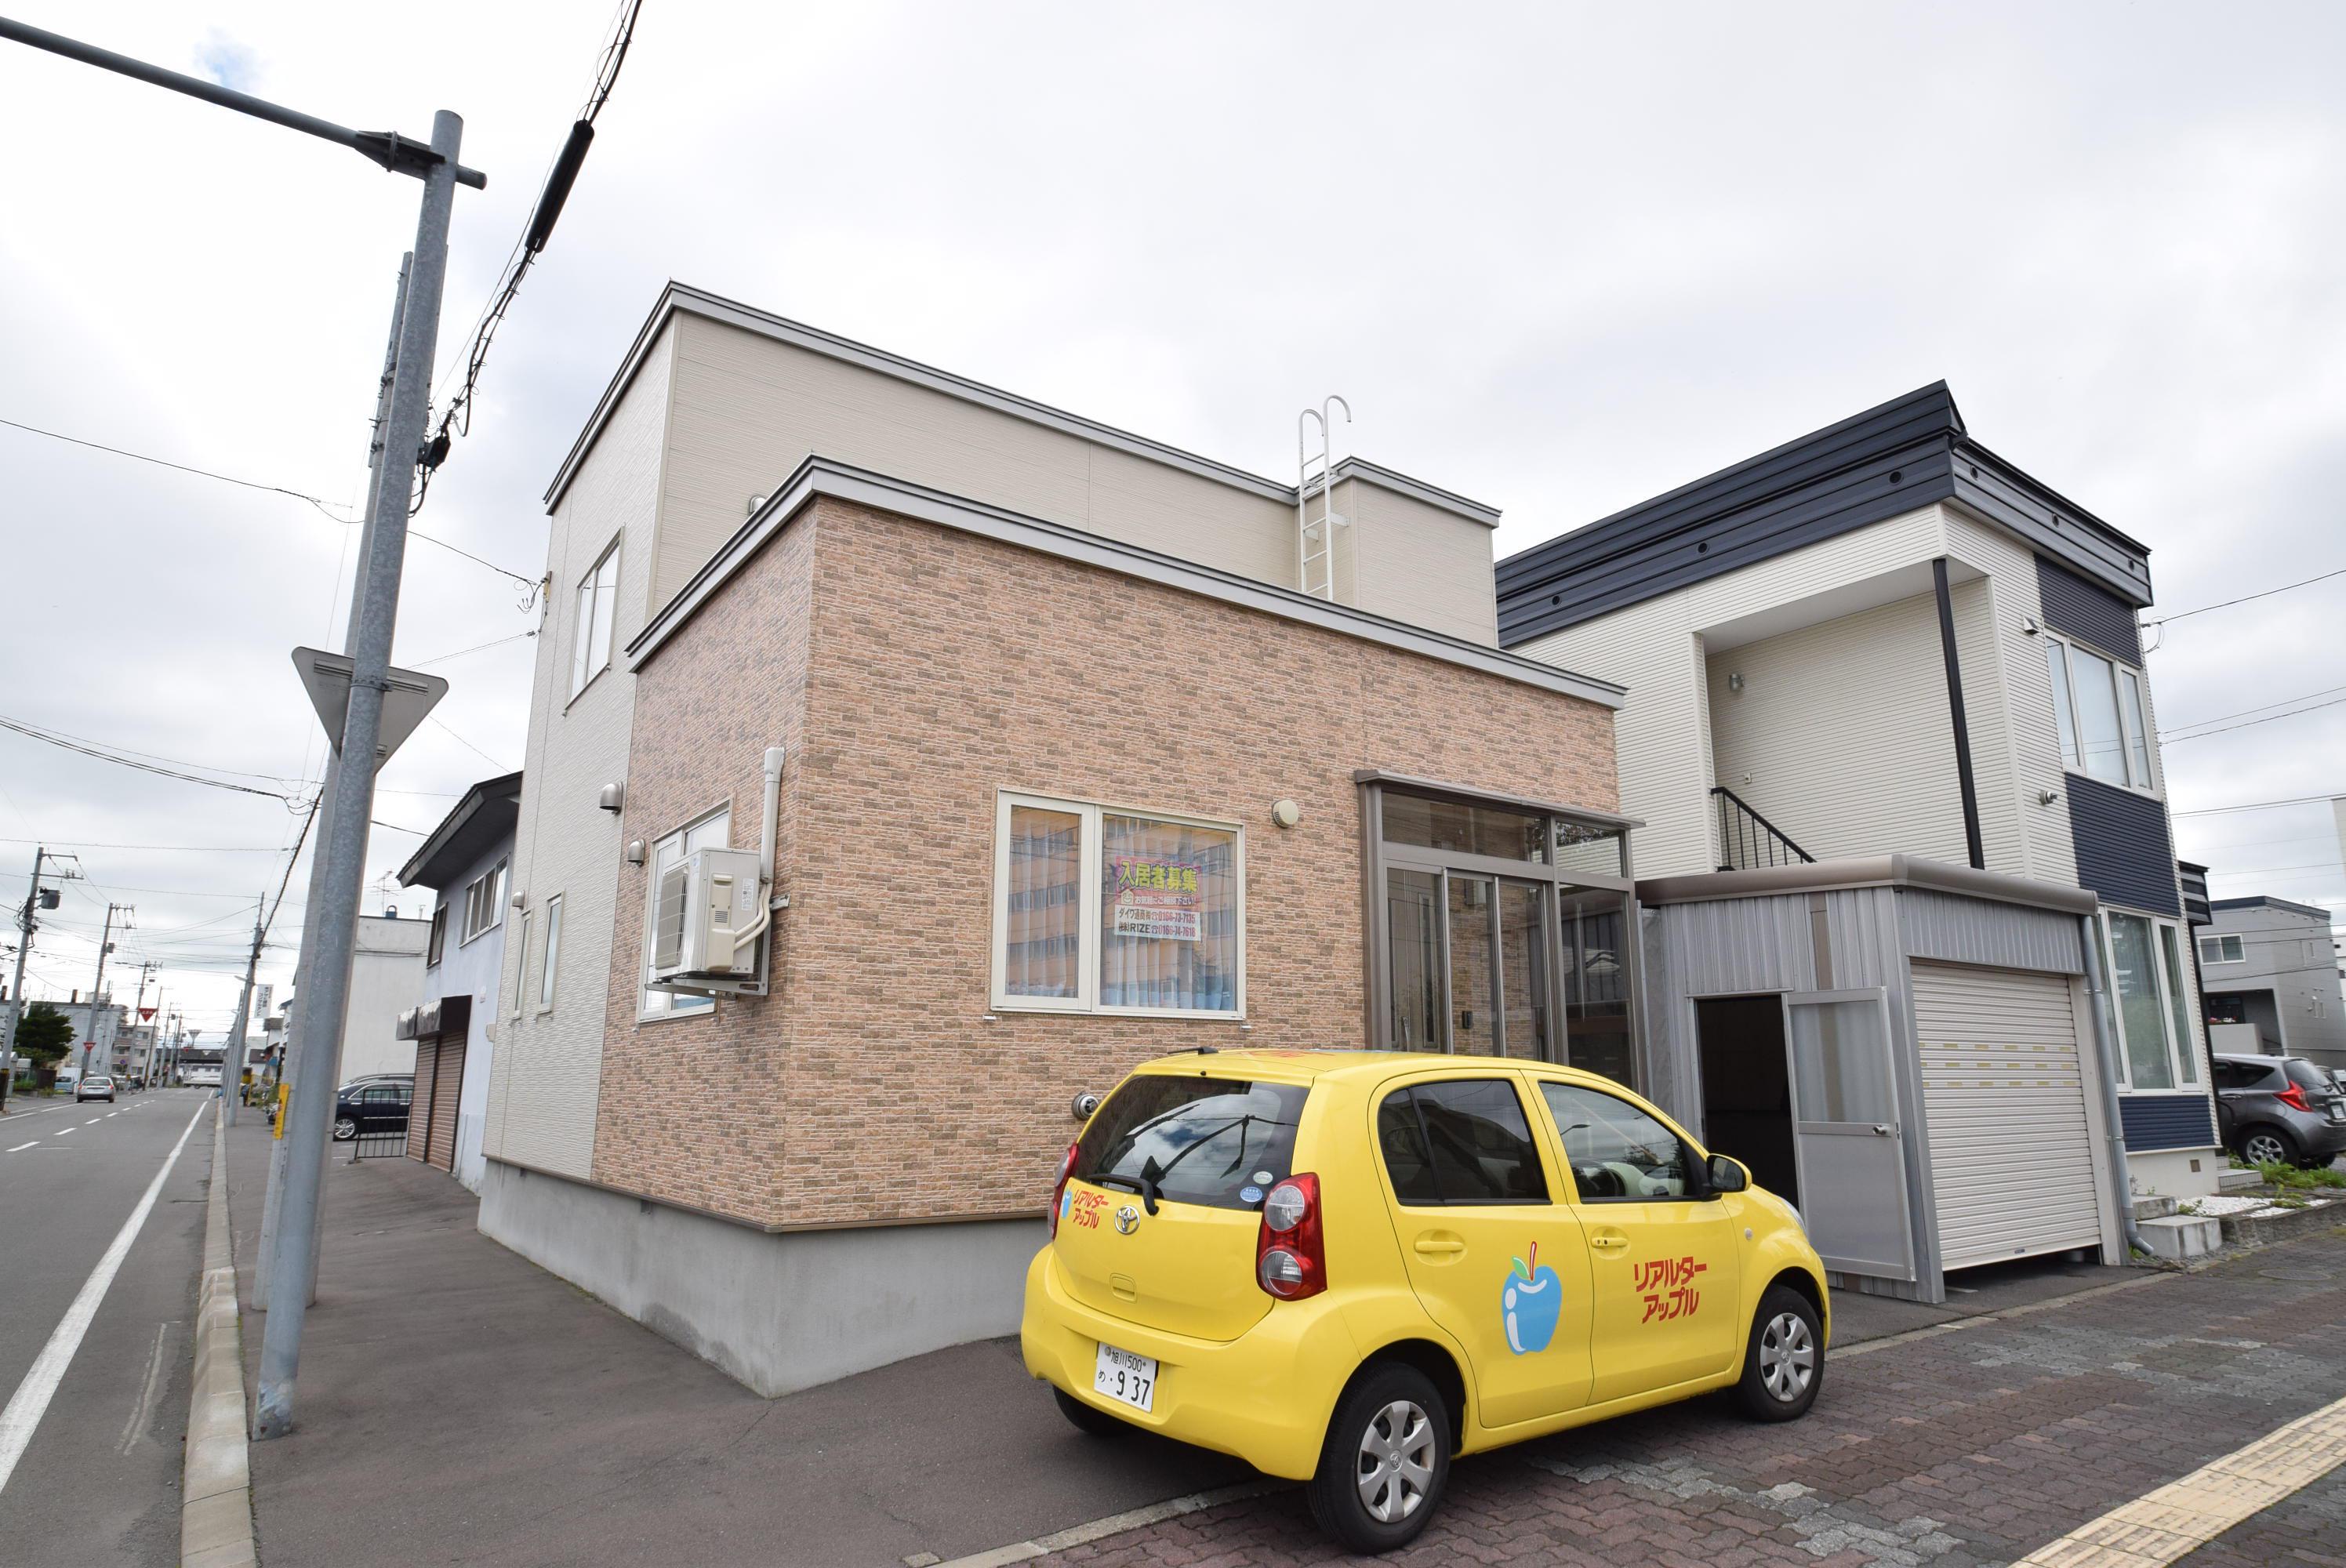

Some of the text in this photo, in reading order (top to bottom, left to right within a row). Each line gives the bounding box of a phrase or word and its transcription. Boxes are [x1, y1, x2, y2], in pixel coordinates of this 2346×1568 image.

[1118, 861, 1197, 892] 入居者募集
[1073, 1189, 1109, 1208] リアルター
[1073, 1208, 1099, 1229] アップル
[1633, 1256, 1707, 1293] リアルター
[1642, 1286, 1700, 1324] アップル
